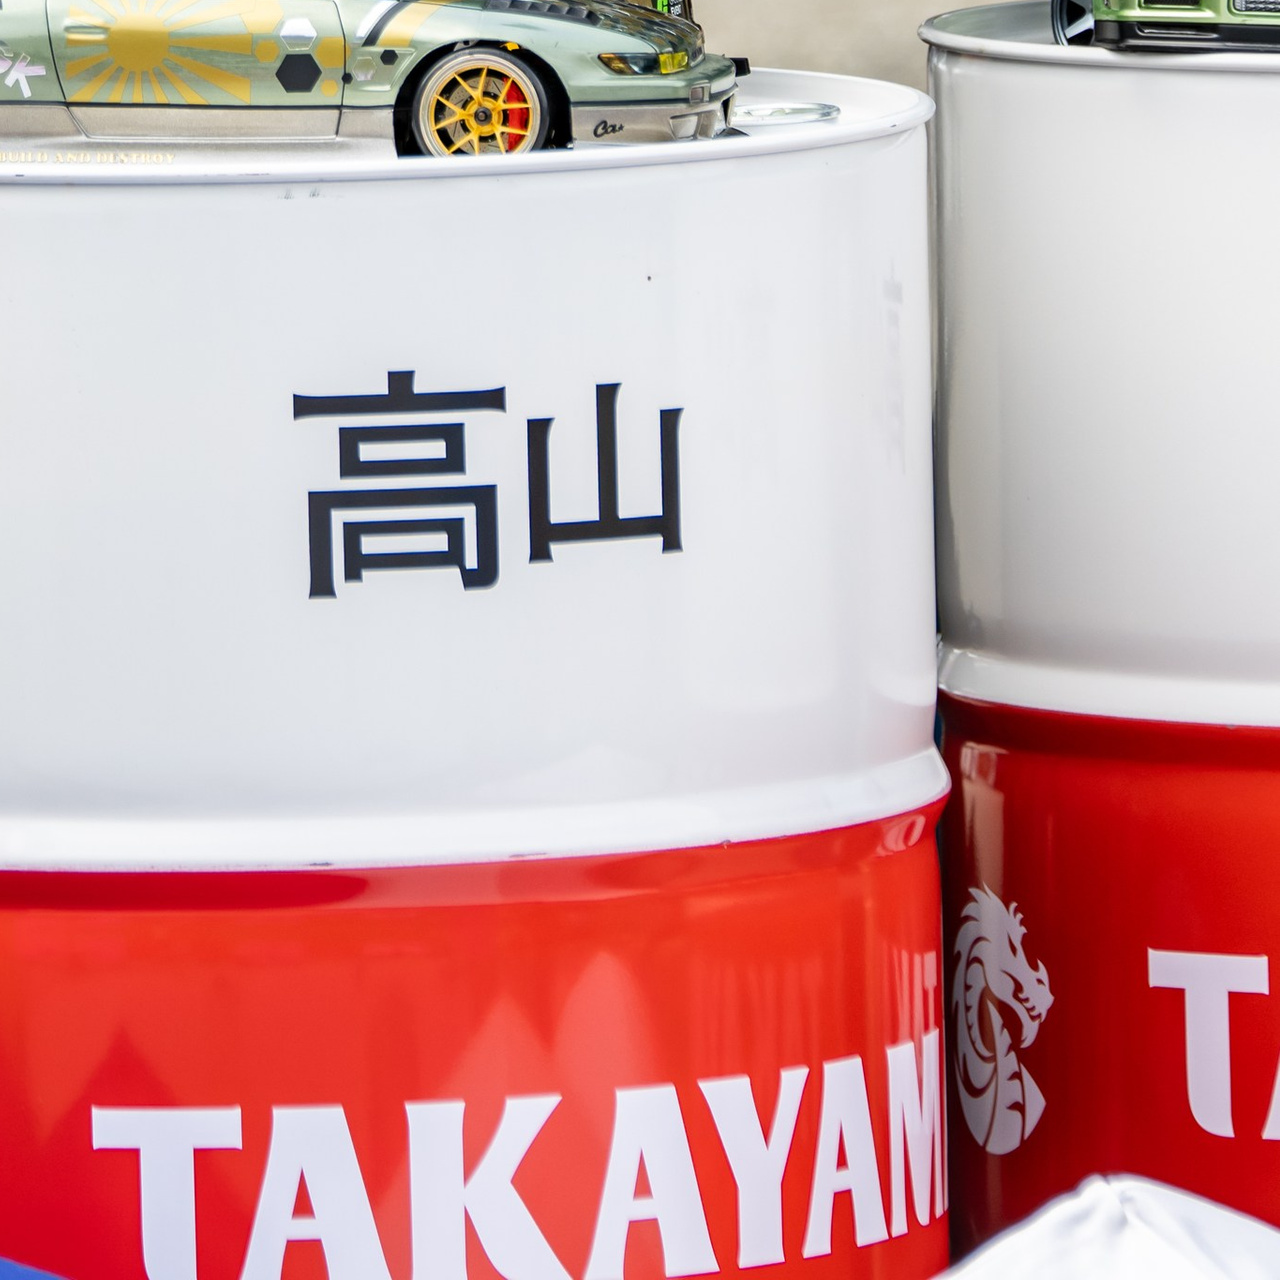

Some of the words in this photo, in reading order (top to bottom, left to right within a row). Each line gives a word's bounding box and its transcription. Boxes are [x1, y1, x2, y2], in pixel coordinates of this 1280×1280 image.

[54, 152, 91, 163] AND
[96, 152, 176, 164] DESTROY
[292, 369, 685, 600] 高山
[1147, 947, 1280, 1140] T
[91, 1026, 950, 1280] TAKAYAM
